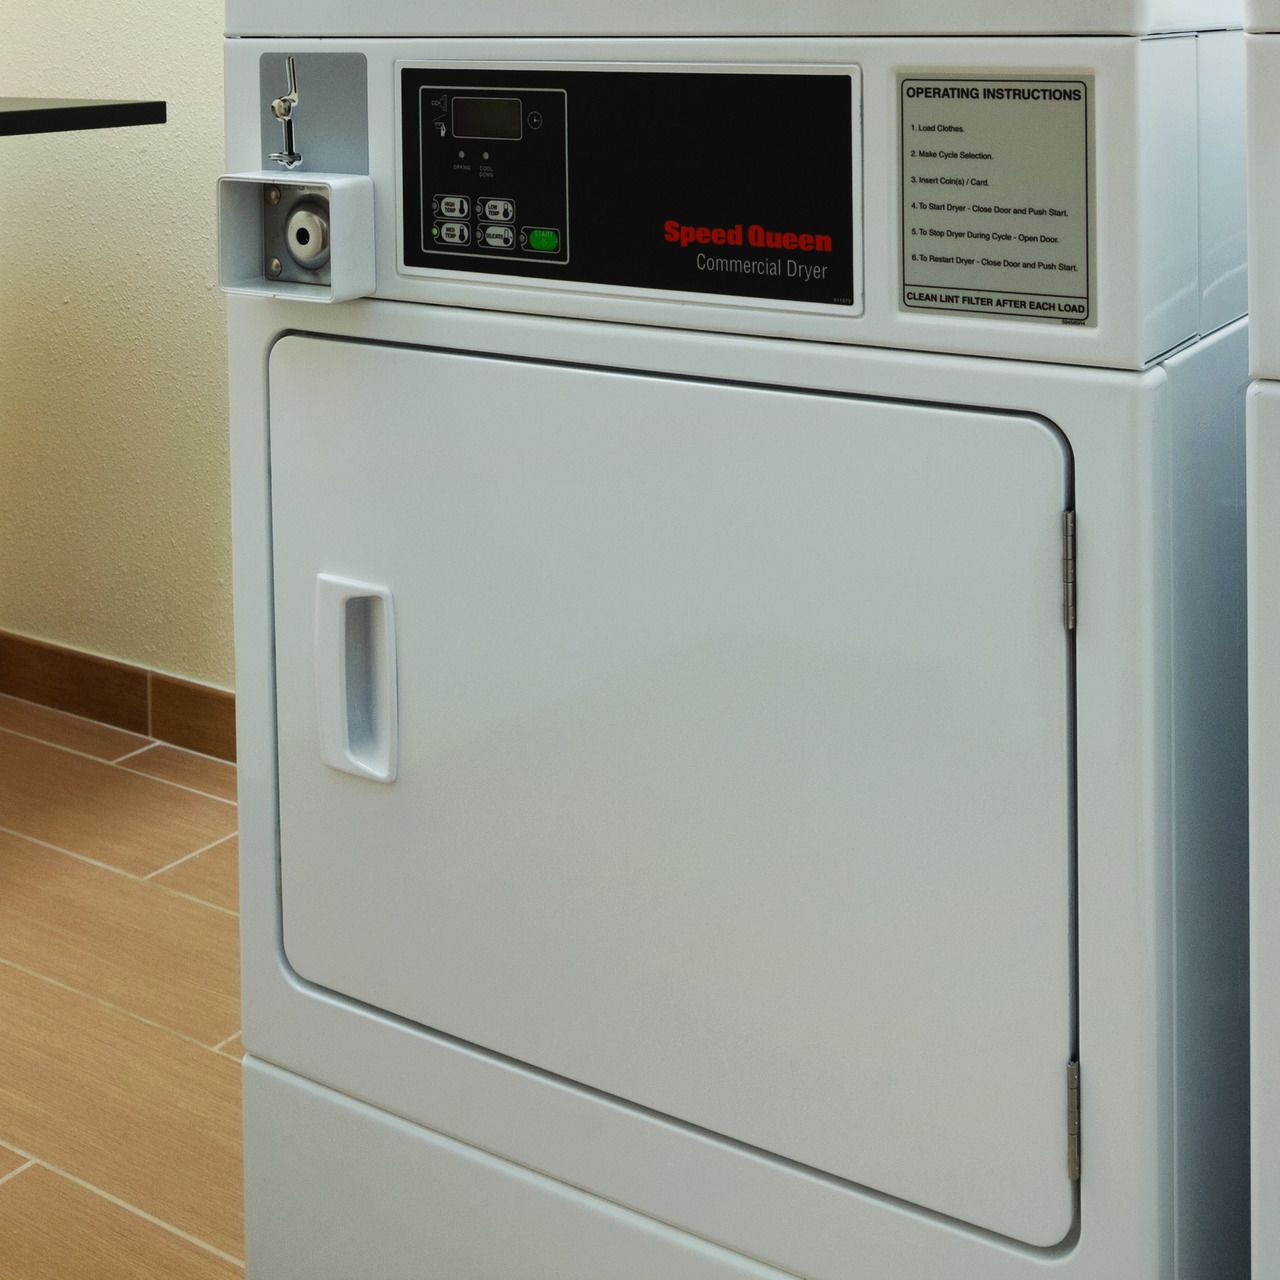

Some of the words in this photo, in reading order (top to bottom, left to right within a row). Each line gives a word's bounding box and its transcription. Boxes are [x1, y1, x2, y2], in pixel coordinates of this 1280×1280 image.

[906, 87, 980, 99] OPERATING
[983, 88, 1081, 101] INSTRUCTIONS
[937, 125, 964, 133] Clothes.
[919, 151, 937, 159] Make
[938, 152, 958, 160] Cycle
[960, 152, 993, 160] Selection.
[911, 176, 917, 184] 3.
[919, 177, 938, 185] Insert
[940, 177, 964, 187] Coin(s)
[966, 178, 969, 186] /
[970, 179, 989, 187] Card.
[928, 203, 945, 211] Start
[947, 204, 966, 213] Dryer
[972, 205, 992, 213] Close
[994, 206, 1011, 214] Door
[1013, 207, 1026, 215] and
[1028, 208, 1046, 216] Push
[1048, 209, 1068, 217] Start.
[664, 220, 743, 247] Speed
[748, 224, 832, 252] Queen
[919, 228, 927, 236] To
[929, 229, 945, 239] Stop
[946, 230, 965, 240] Dryer
[967, 230, 990, 241] During
[992, 232, 1012, 242] Cycle
[1018, 233, 1038, 244] Open
[1040, 234, 1059, 243] Door.
[696, 253, 781, 276] Commercial
[786, 259, 828, 281] Dryer
[919, 254, 927, 262] To
[929, 255, 955, 264] Restart
[956, 256, 975, 266] Dryer
[981, 258, 1001, 267] Close
[1003, 259, 1020, 268] Door
[1022, 260, 1036, 269] and
[1038, 261, 1056, 270] Push
[1058, 262, 1078, 272] Start.
[907, 291, 938, 303] CLEAN
[939, 293, 959, 304] LINT
[962, 295, 993, 307] FILTER
[995, 297, 1027, 309] AFTER
[1029, 300, 1055, 311] EACH
[1058, 302, 1085, 314] LOAD
